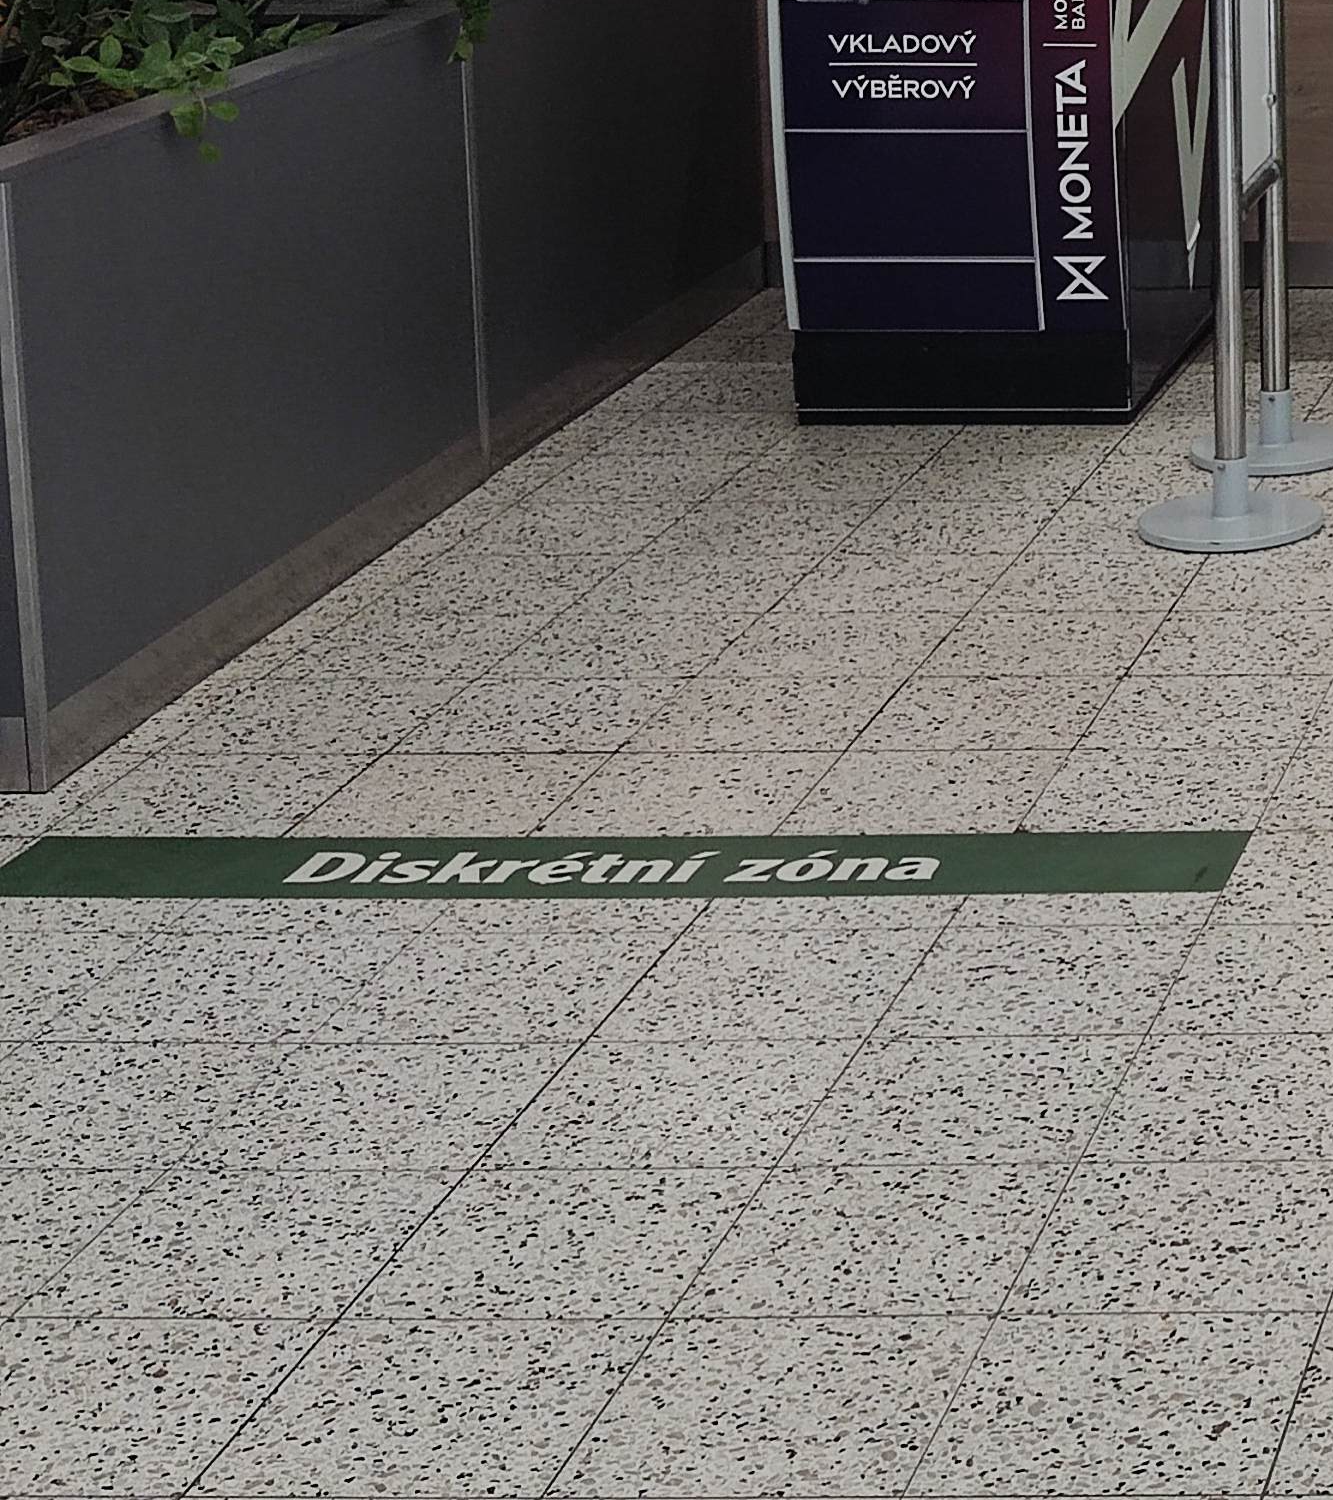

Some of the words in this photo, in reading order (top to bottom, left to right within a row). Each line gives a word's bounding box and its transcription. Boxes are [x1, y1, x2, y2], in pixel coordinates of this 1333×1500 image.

[828, 30, 977, 54] VKLADOVÝ
[831, 74, 976, 99] VÝBĚROVÝ
[1054, 59, 1094, 240] MONETA
[282, 850, 720, 884] Diskrétní
[723, 848, 940, 884] zóna
